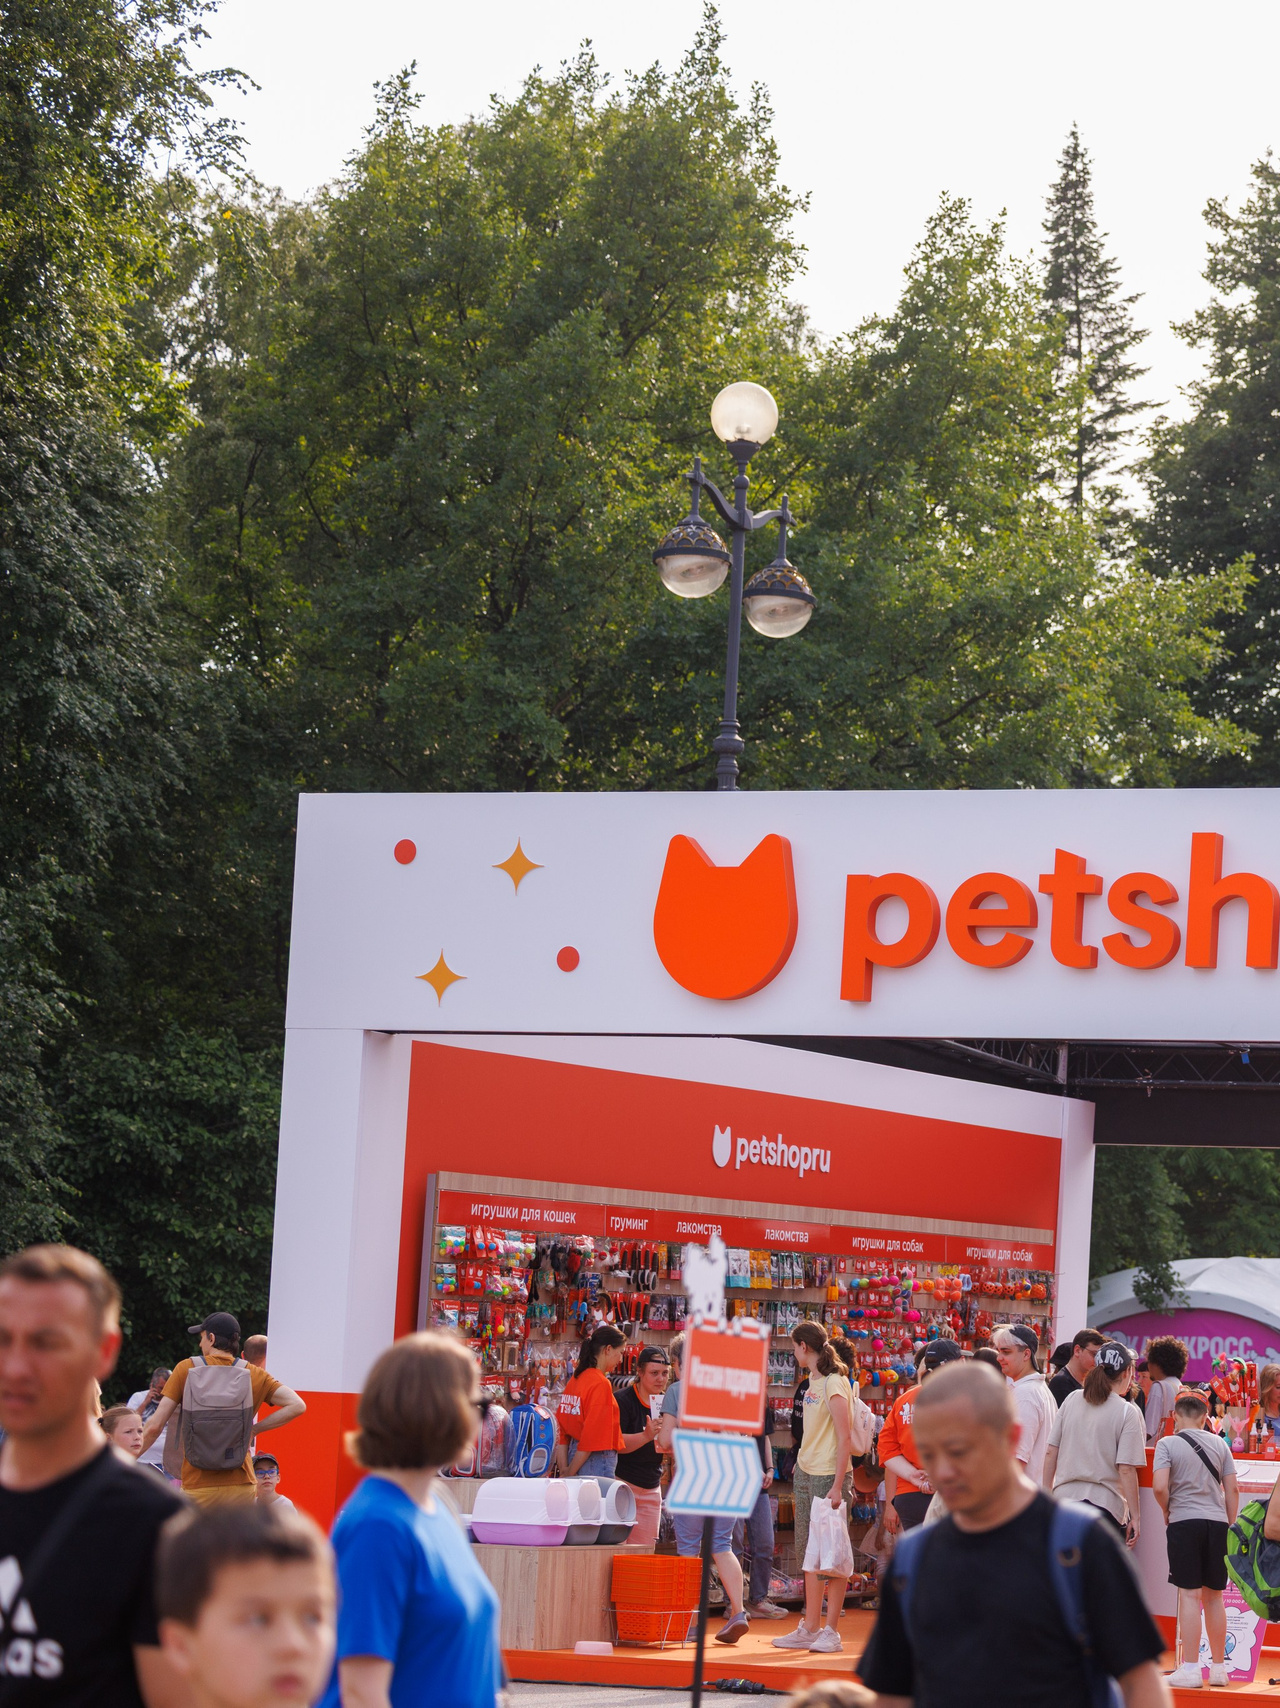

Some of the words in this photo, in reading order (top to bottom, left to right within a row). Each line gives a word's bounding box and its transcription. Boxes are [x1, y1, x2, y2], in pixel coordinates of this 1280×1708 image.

[735, 1133, 831, 1178] petshopru
[471, 1203, 518, 1221] игрушки
[520, 1207, 541, 1222] для
[543, 1209, 576, 1224] кошек
[610, 1215, 649, 1233] груминг
[676, 1221, 722, 1236] лакомства
[764, 1228, 809, 1243] лакомства
[852, 1236, 885, 1251] игрушки
[886, 1240, 901, 1252] для
[902, 1239, 924, 1253] собак
[966, 1246, 997, 1261] игрушки
[997, 1249, 1011, 1262] для
[1011, 1248, 1033, 1262] собак
